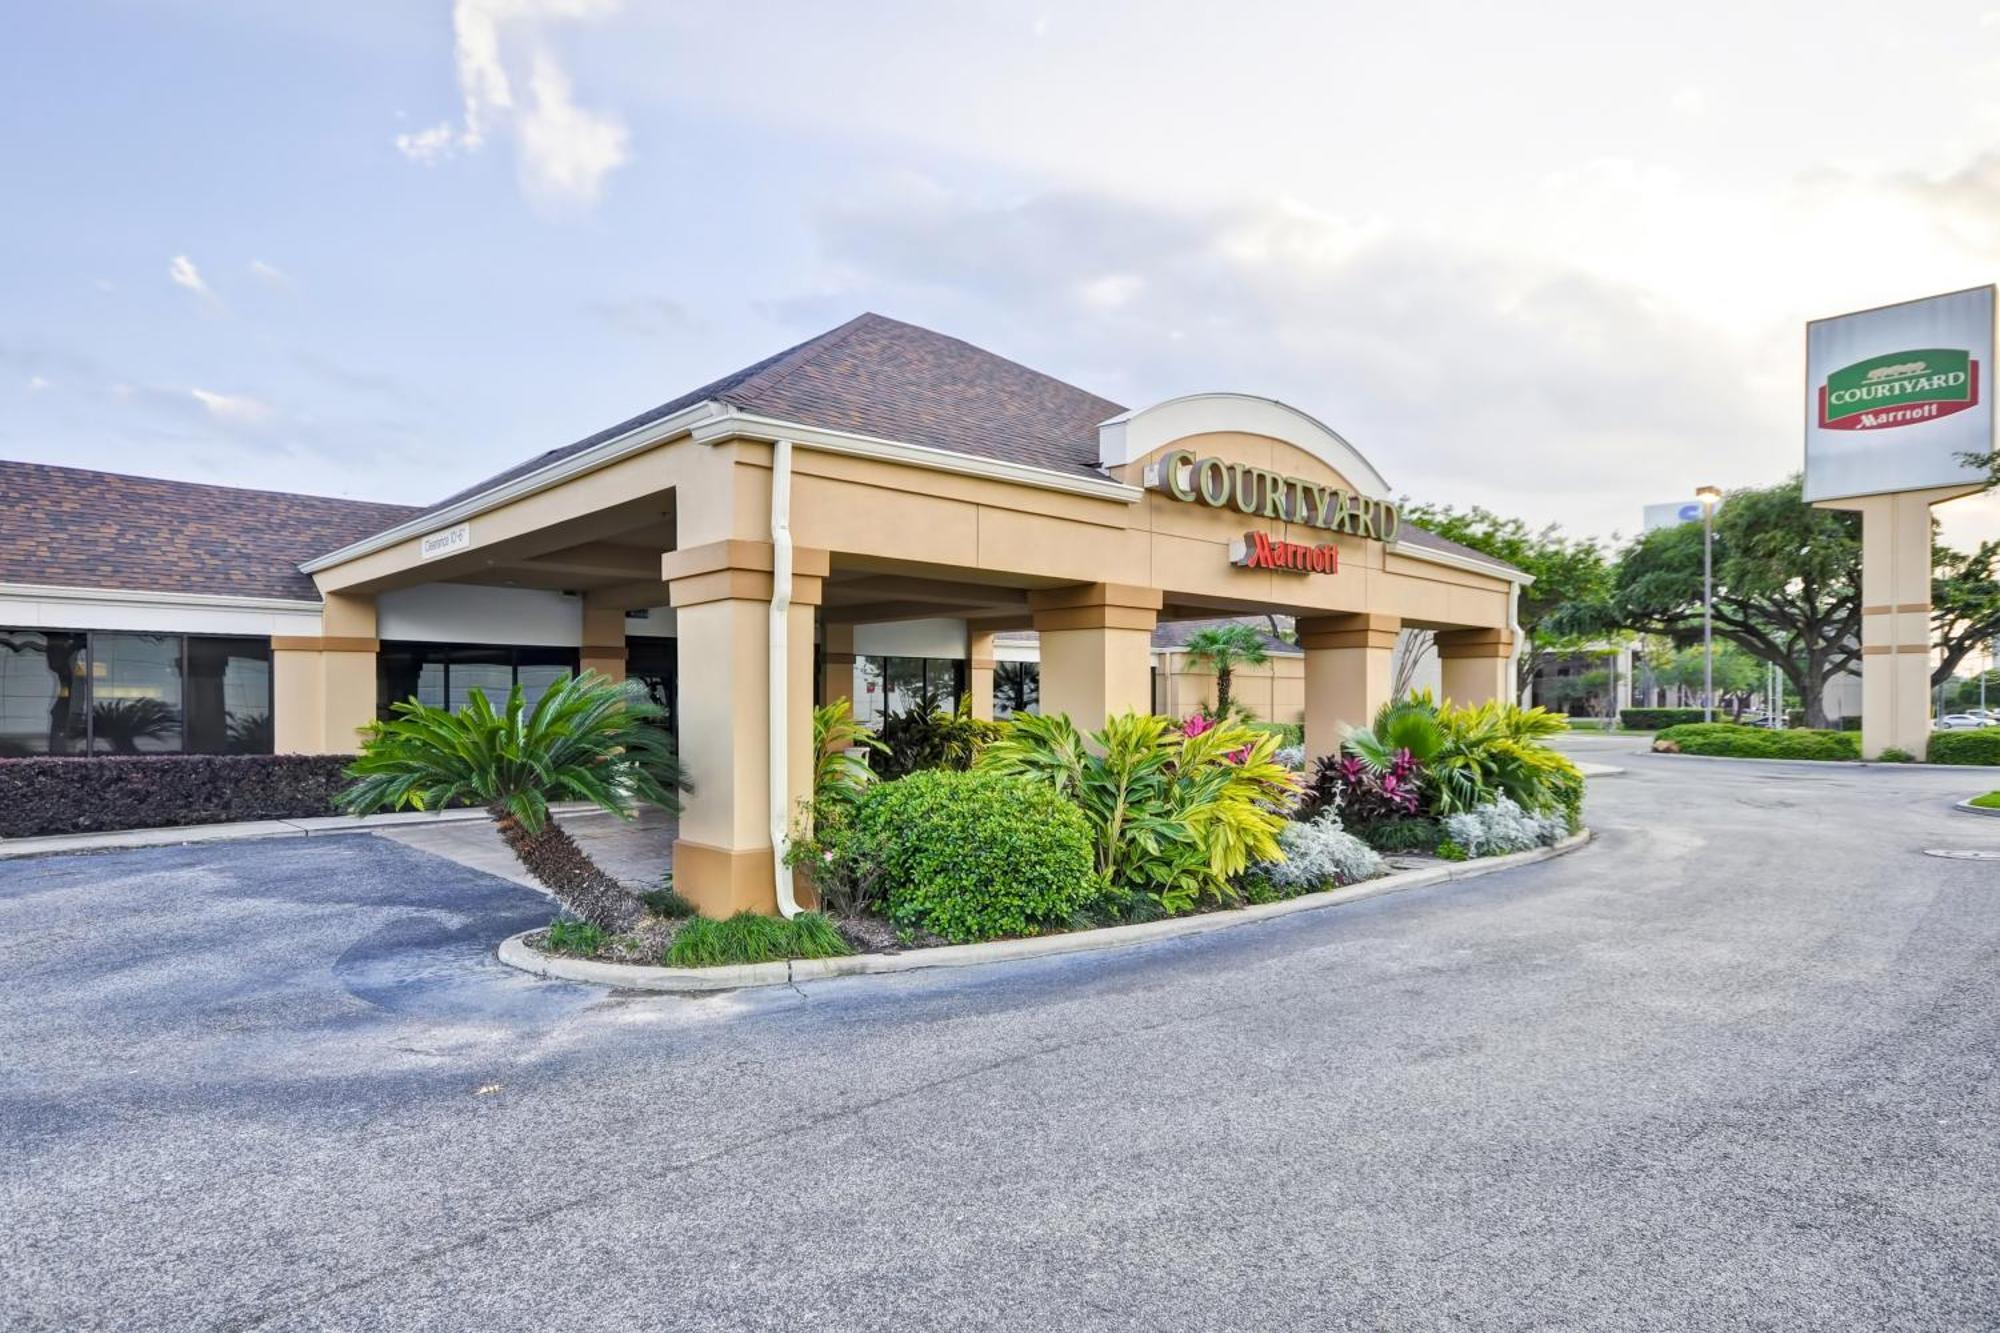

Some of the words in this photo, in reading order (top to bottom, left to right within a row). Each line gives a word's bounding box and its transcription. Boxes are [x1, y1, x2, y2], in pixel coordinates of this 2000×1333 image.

[1830, 371, 1965, 404] COURTYARD
[1856, 403, 1939, 429] Marriott
[1163, 449, 1400, 543] COURTYARD
[1247, 530, 1338, 574] Marriott
